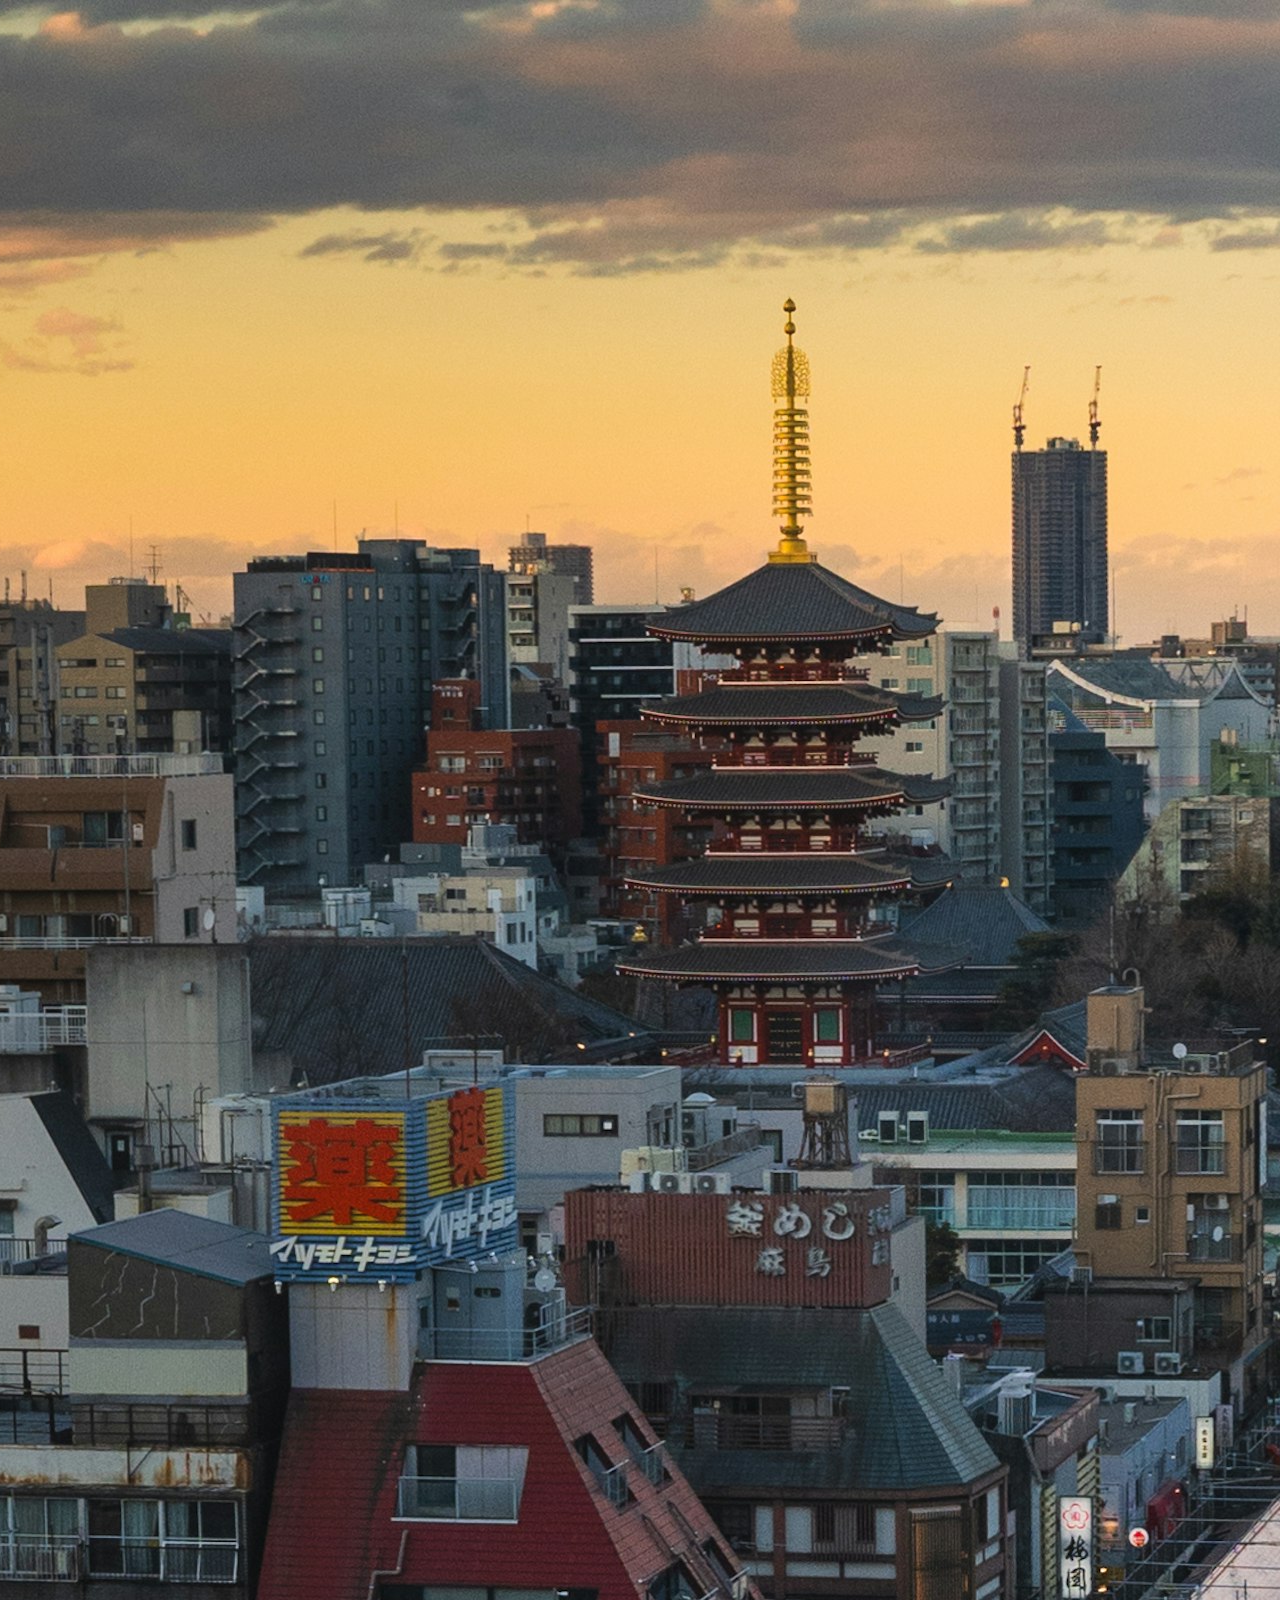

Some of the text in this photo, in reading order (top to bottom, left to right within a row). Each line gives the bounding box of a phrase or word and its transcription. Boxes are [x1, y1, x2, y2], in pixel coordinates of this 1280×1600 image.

[284, 1118, 400, 1225] 薬
[448, 1091, 488, 1188] 薬
[269, 1236, 417, 1272] マツモトキヨシ
[423, 1187, 519, 1257] マツモトキヨシ
